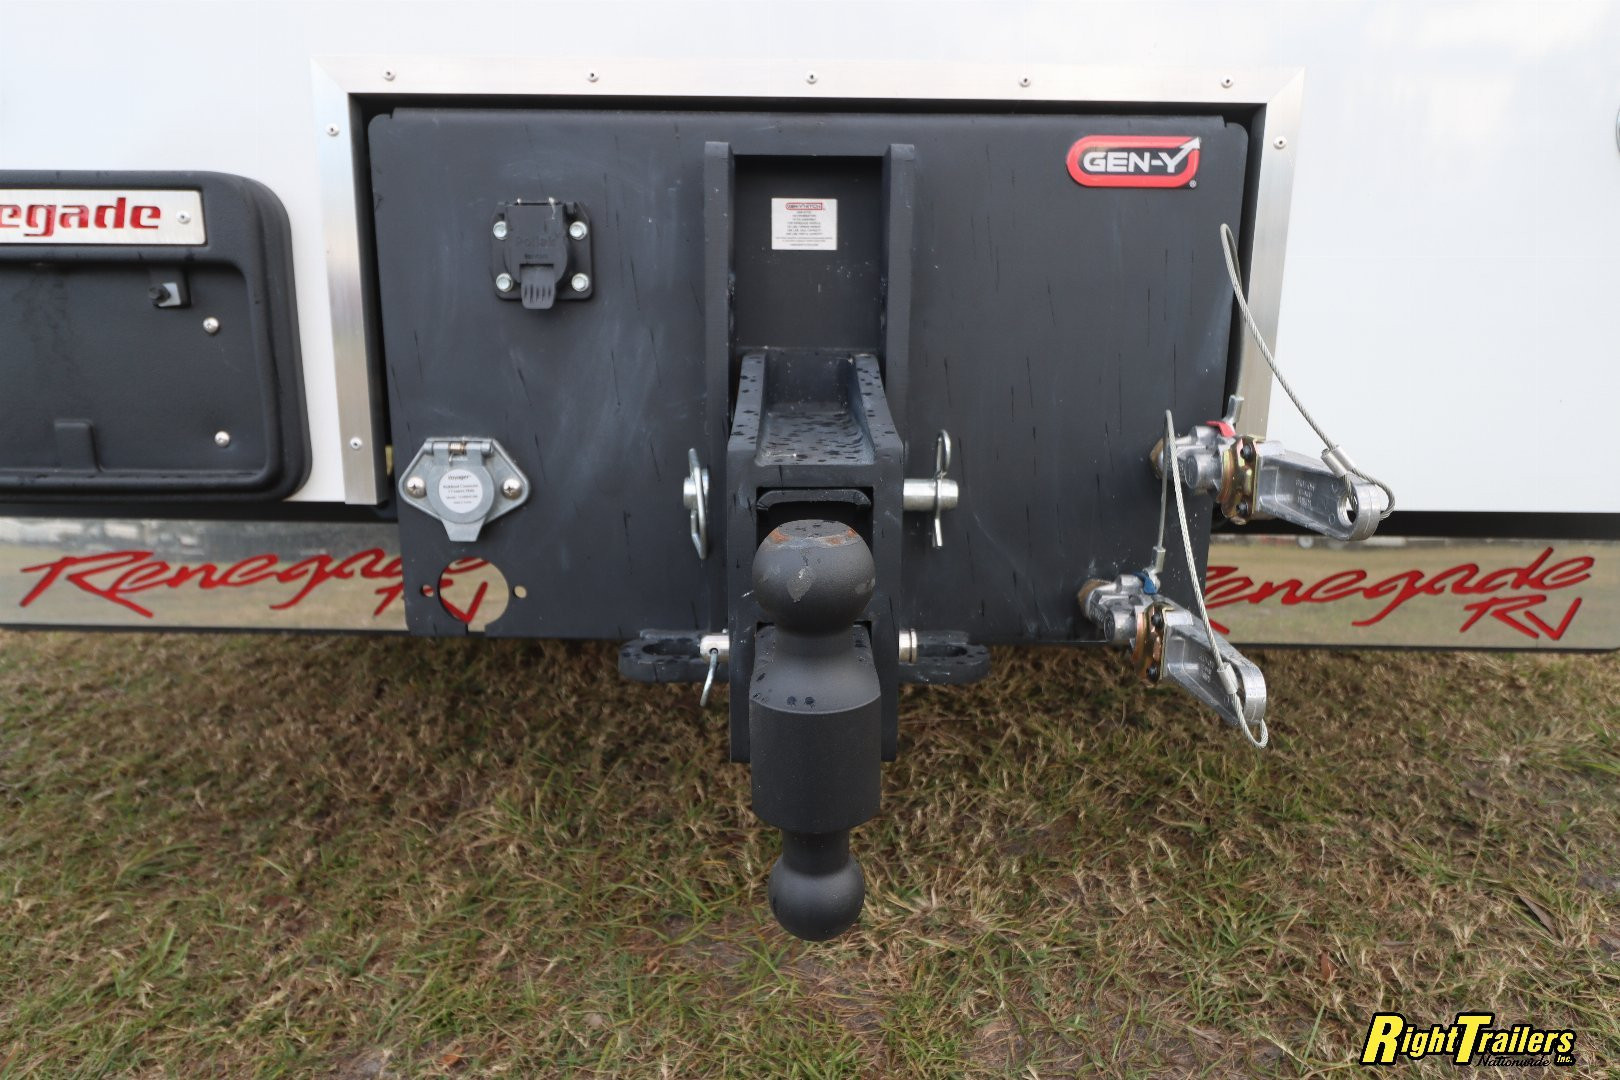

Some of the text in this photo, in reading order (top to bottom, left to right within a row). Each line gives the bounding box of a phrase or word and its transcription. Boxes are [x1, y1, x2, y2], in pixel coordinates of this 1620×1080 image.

[1083, 142, 1193, 173] GEN-Y
[20, 548, 490, 618] Renegae
[1460, 595, 1582, 640] RV
